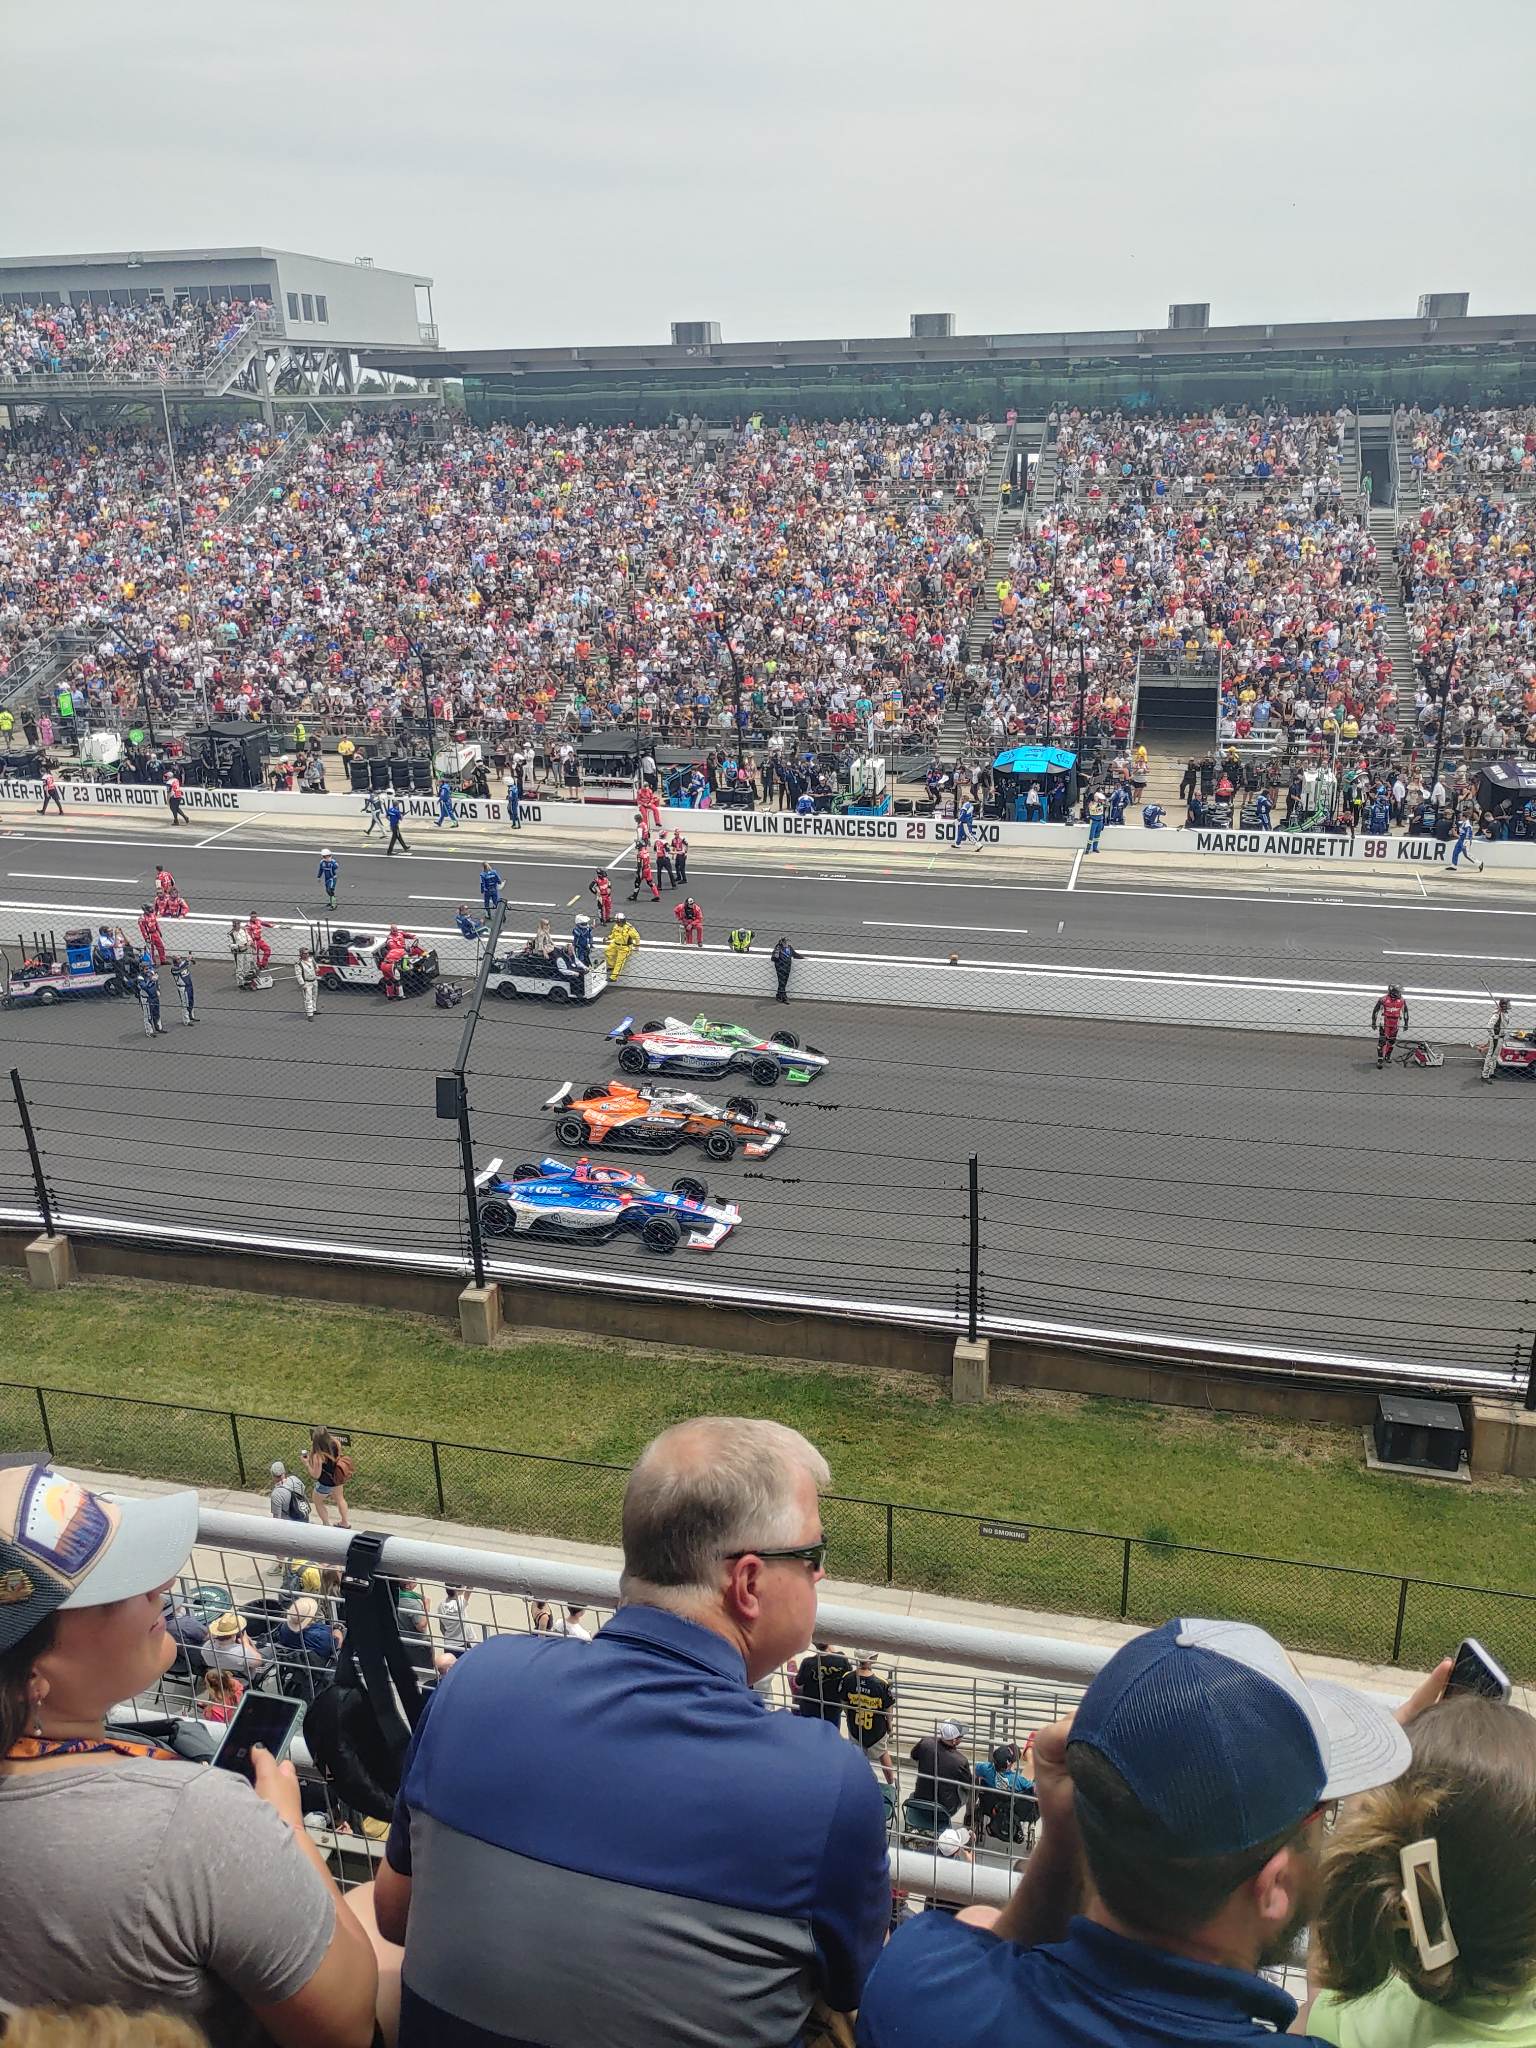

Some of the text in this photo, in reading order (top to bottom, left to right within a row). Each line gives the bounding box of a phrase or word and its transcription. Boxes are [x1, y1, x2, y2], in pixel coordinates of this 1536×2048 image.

[72, 786, 90, 801] 23
[96, 787, 122, 803] DRR
[126, 788, 159, 806] ROOT
[485, 803, 501, 820] 18
[511, 805, 542, 822] MD
[723, 814, 778, 834] DEVLIN
[783, 817, 898, 839] DEFRANCESCO
[906, 822, 926, 840] 29
[1197, 833, 1446, 861] MARCO ANDRETTI 98 KULR
[994, 1528, 1026, 1539] SMOKING
